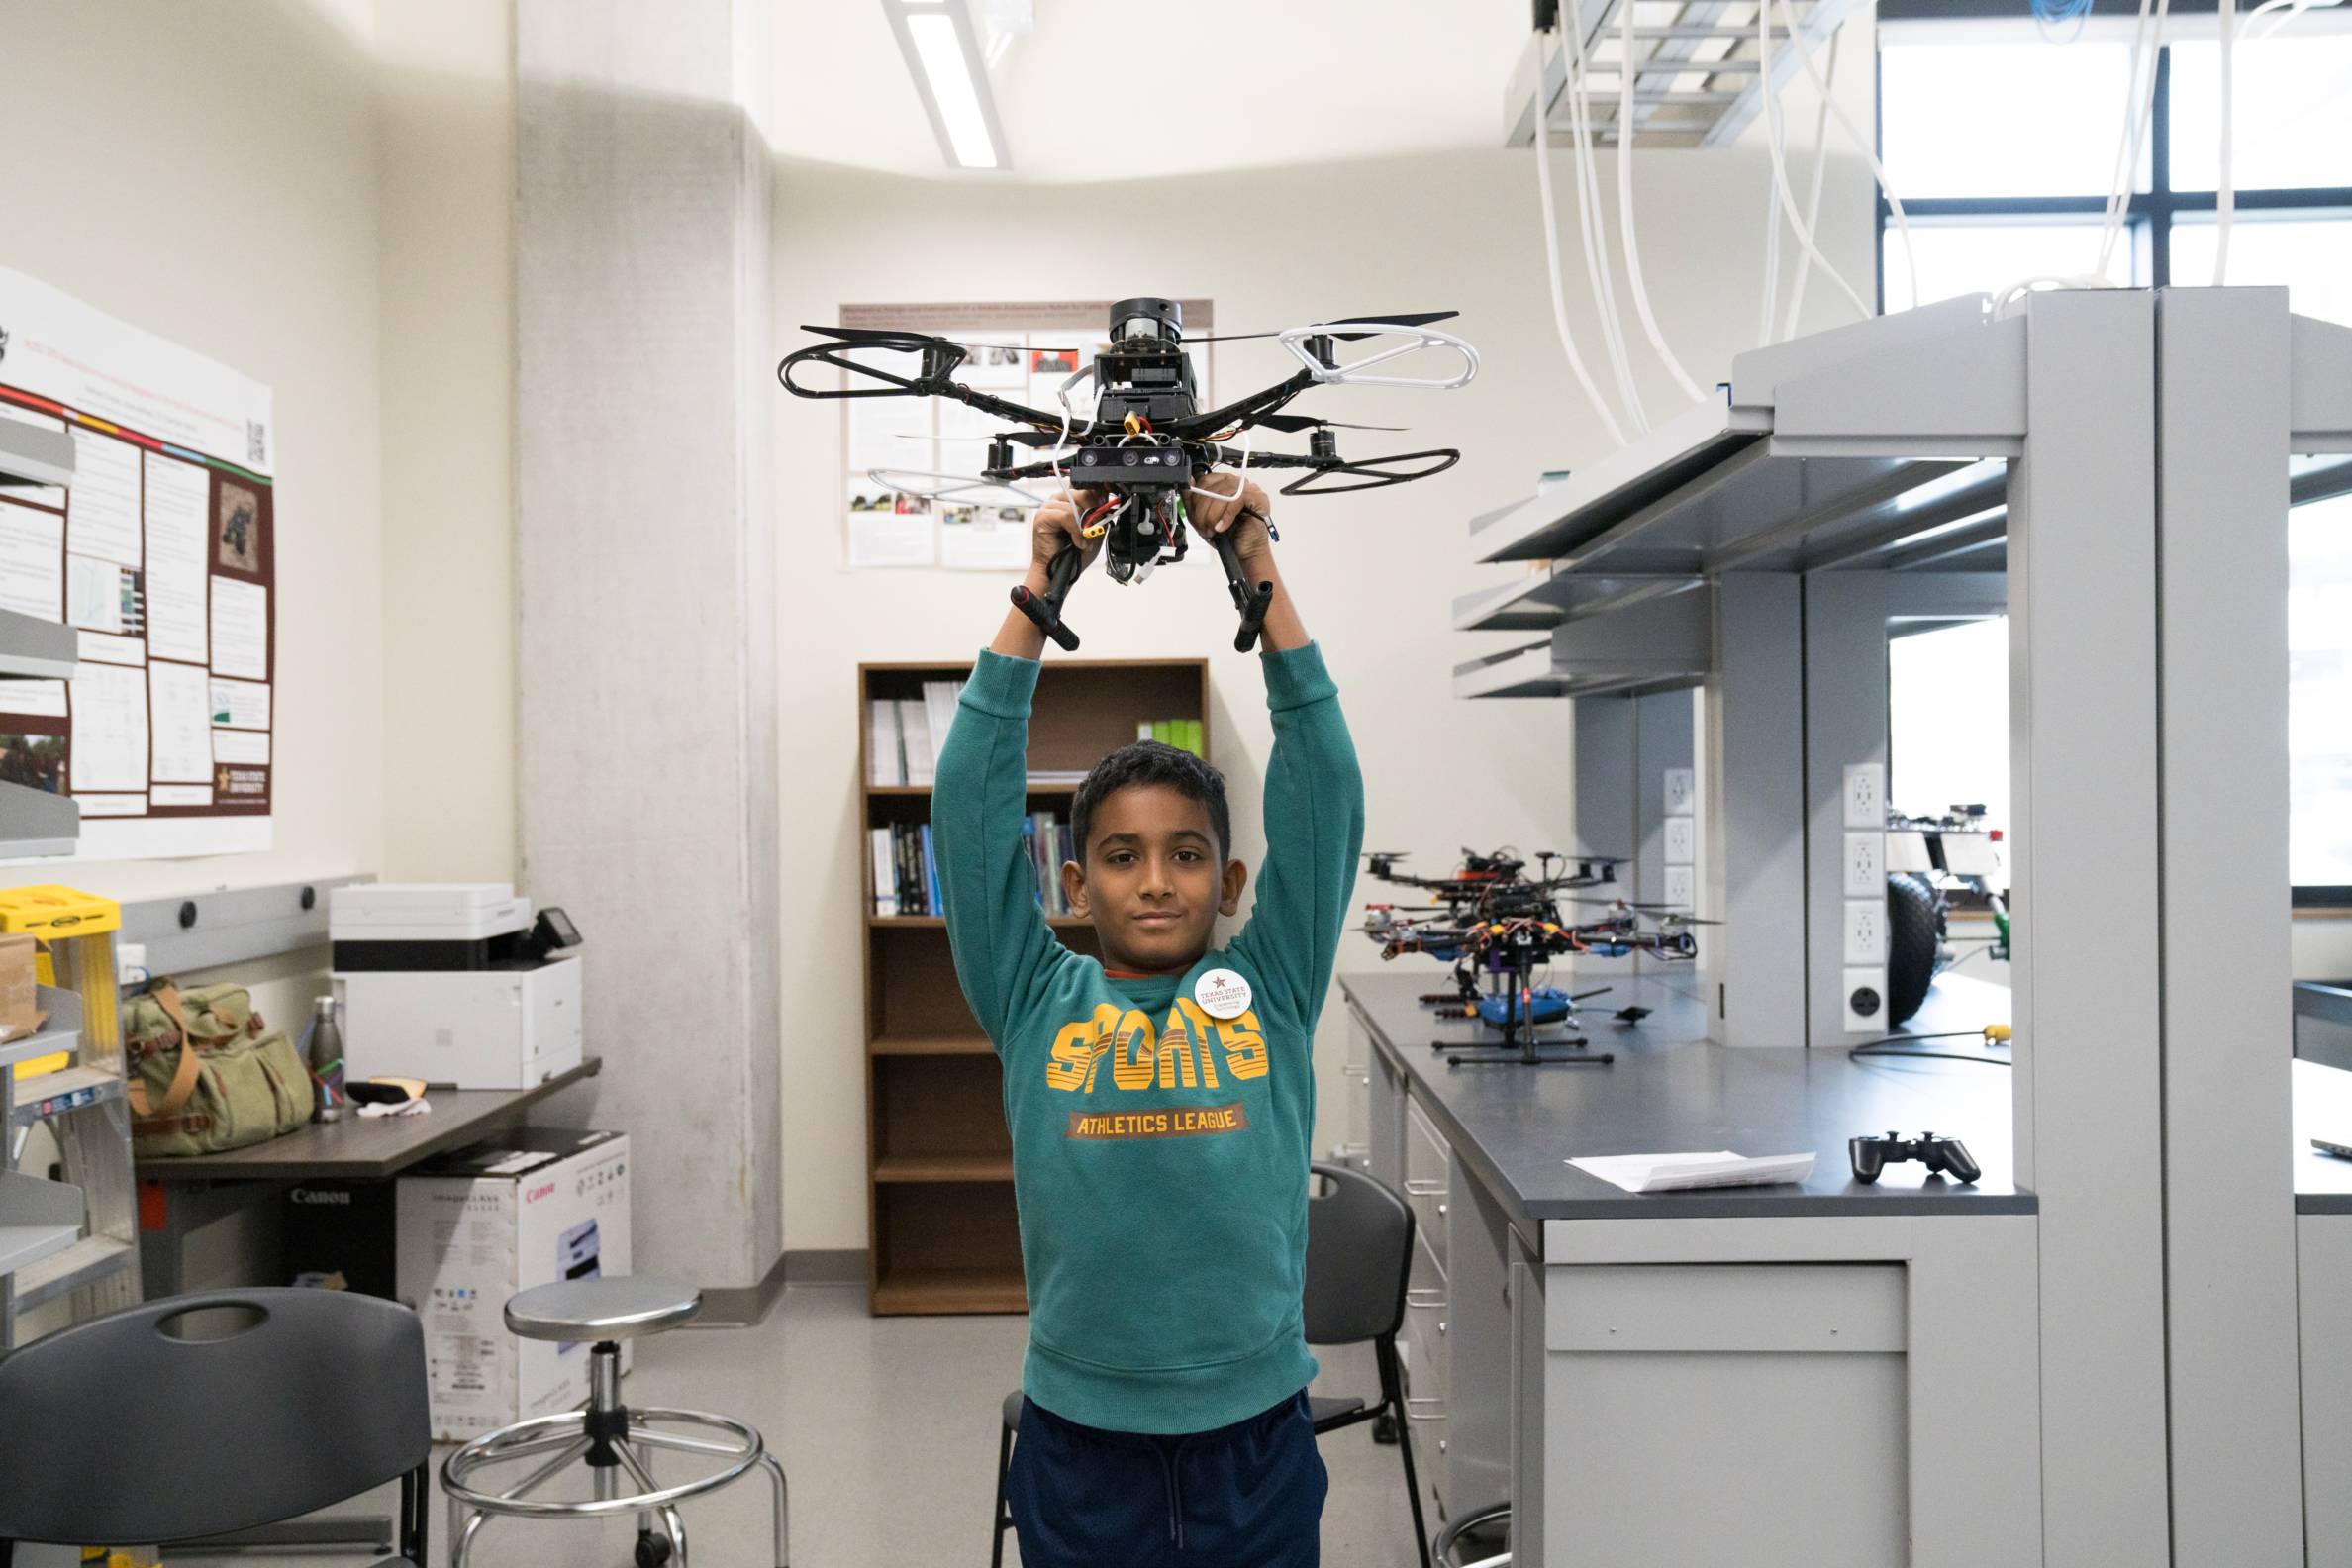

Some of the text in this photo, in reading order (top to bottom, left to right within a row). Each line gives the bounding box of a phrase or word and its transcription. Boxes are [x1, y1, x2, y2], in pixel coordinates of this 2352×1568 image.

[1201, 990, 1224, 999] TEXAS
[1202, 993, 1246, 1005] UNIVERSITY
[1077, 1110, 1237, 1135] ATHLETICS LEAGUE
[290, 1188, 350, 1205] Canon
[526, 1182, 555, 1204] Canon
